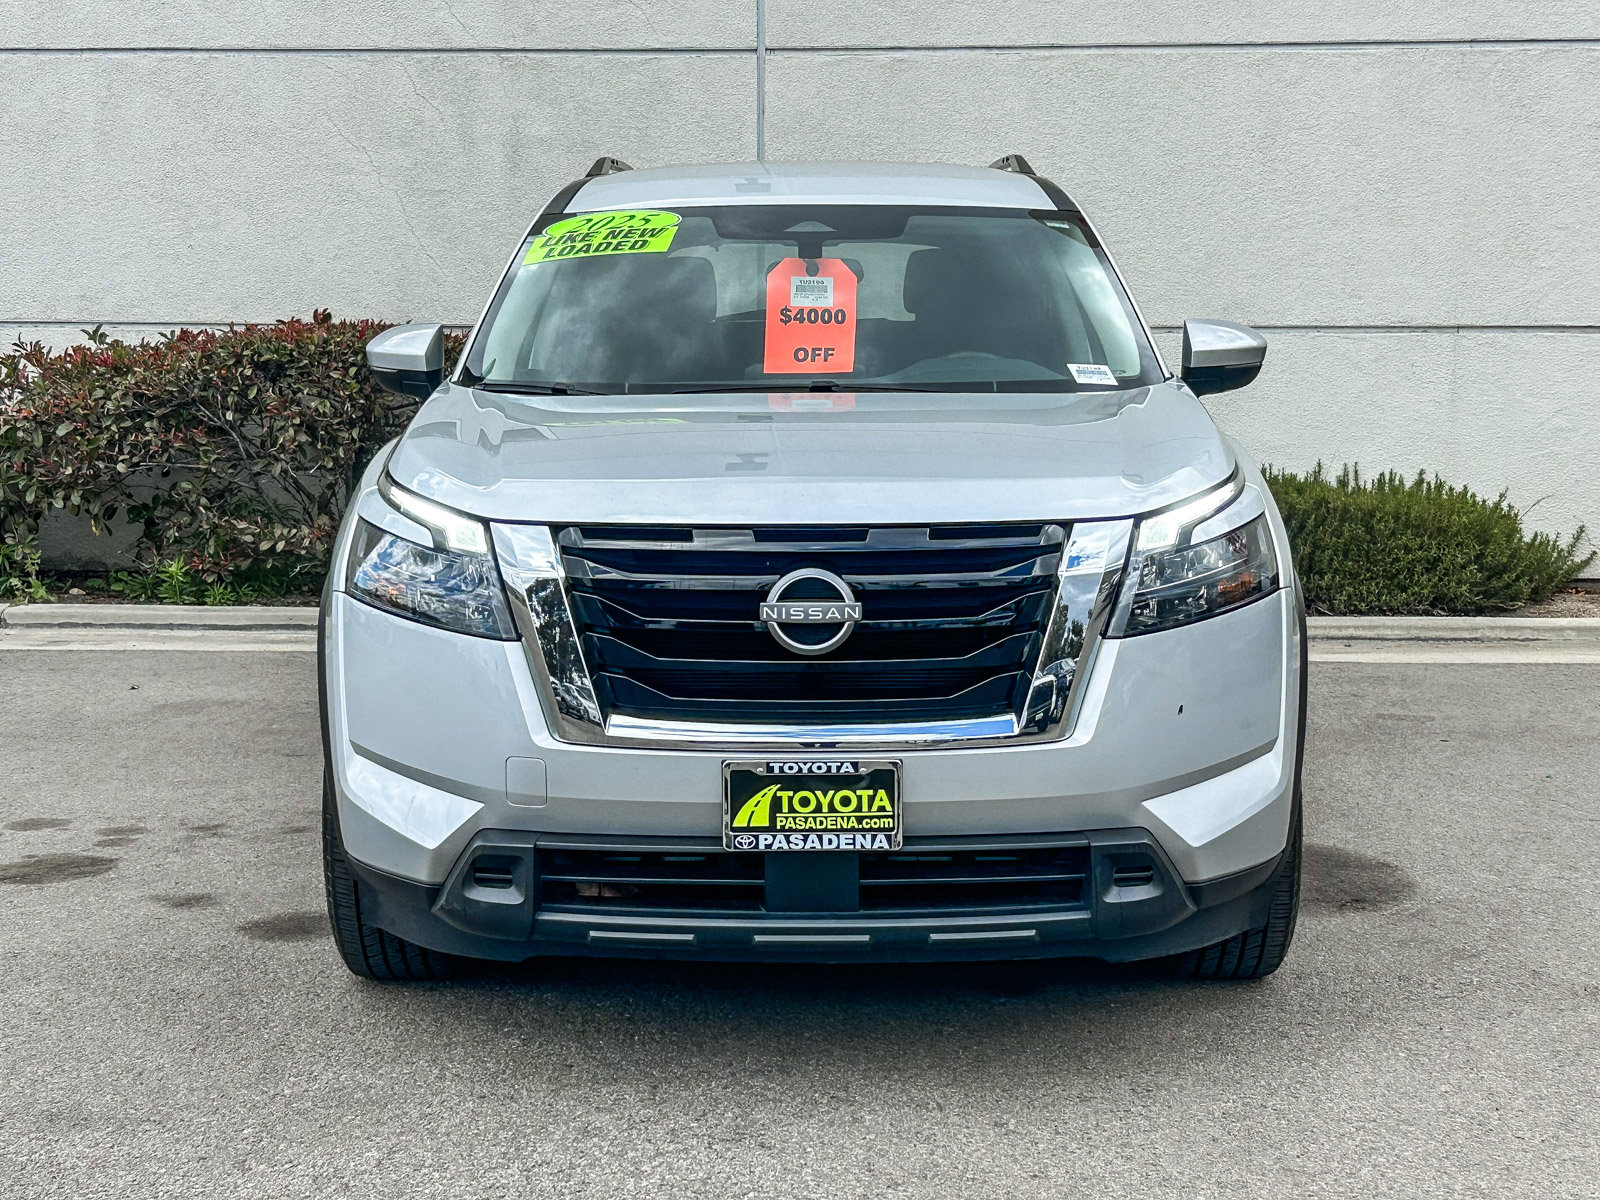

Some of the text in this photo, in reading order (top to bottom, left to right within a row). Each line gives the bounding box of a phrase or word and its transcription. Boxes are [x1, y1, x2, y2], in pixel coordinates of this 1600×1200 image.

[565, 213, 661, 231] 2025
[541, 227, 669, 249] LIKE NEW
[542, 239, 651, 260] LOADED
[779, 305, 846, 326] $4000
[793, 347, 835, 363] OFF
[763, 606, 859, 619] NISSAN
[769, 762, 855, 774] TOYOTA
[776, 789, 893, 813] TOYOTA
[776, 817, 893, 830] PASADENA.com
[758, 834, 889, 850] PASADENA
